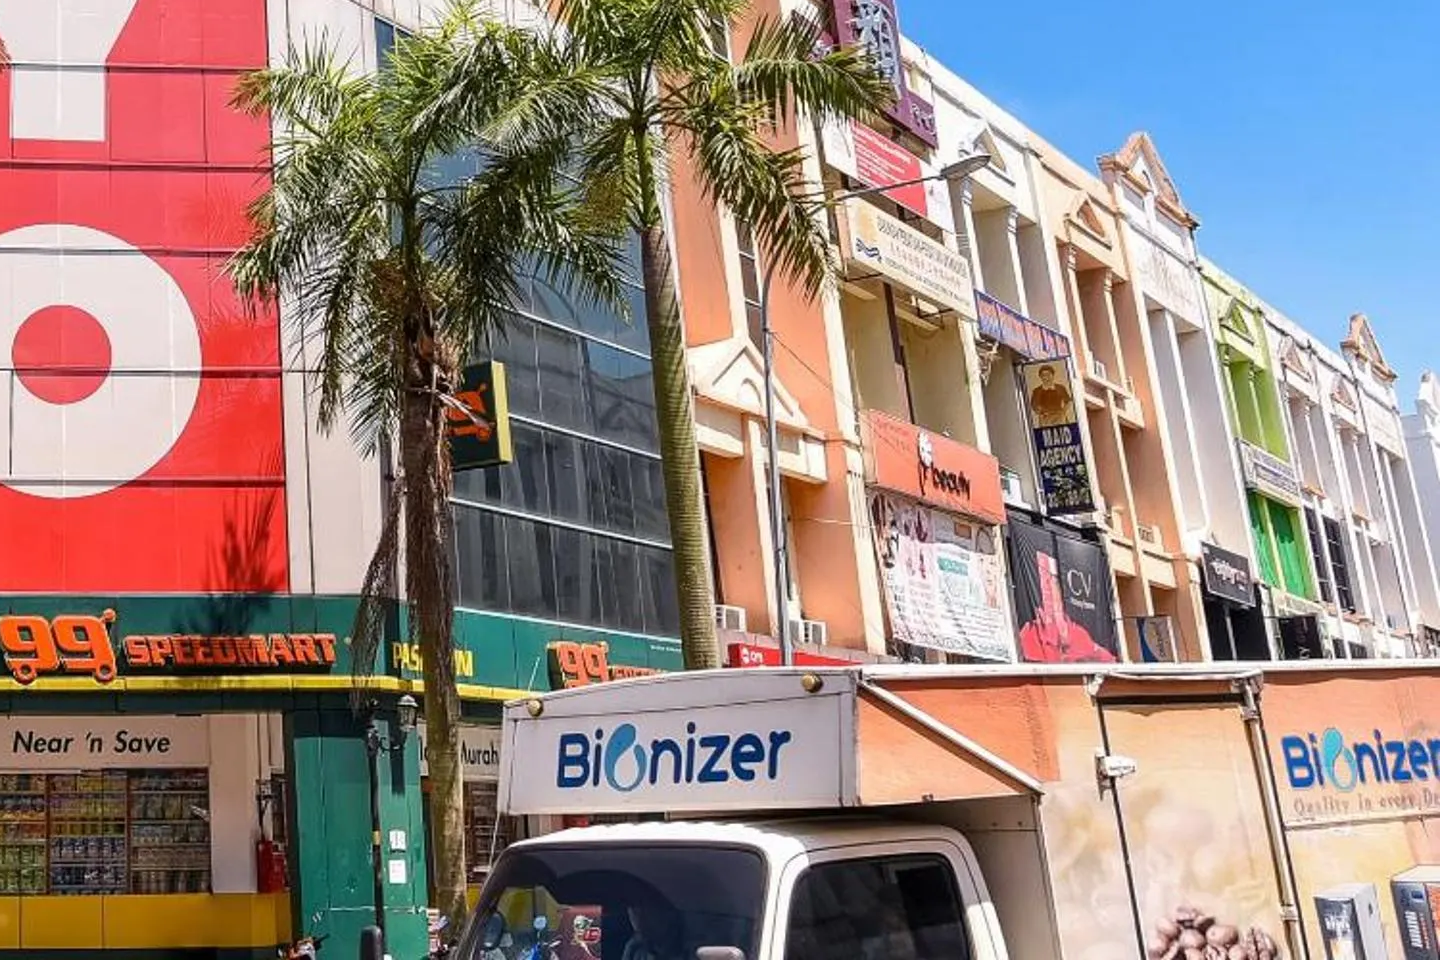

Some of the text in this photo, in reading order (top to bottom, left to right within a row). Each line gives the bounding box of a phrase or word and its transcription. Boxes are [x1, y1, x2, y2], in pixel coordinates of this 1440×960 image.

[1042, 426, 1072, 447] MAID
[1040, 444, 1082, 467] AGENCY
[1066, 568, 1092, 597] CV
[124, 633, 337, 667] SPEEDMART
[13, 730, 74, 754] Near
[114, 730, 171, 754] Save
[557, 721, 791, 792] Bionizer
